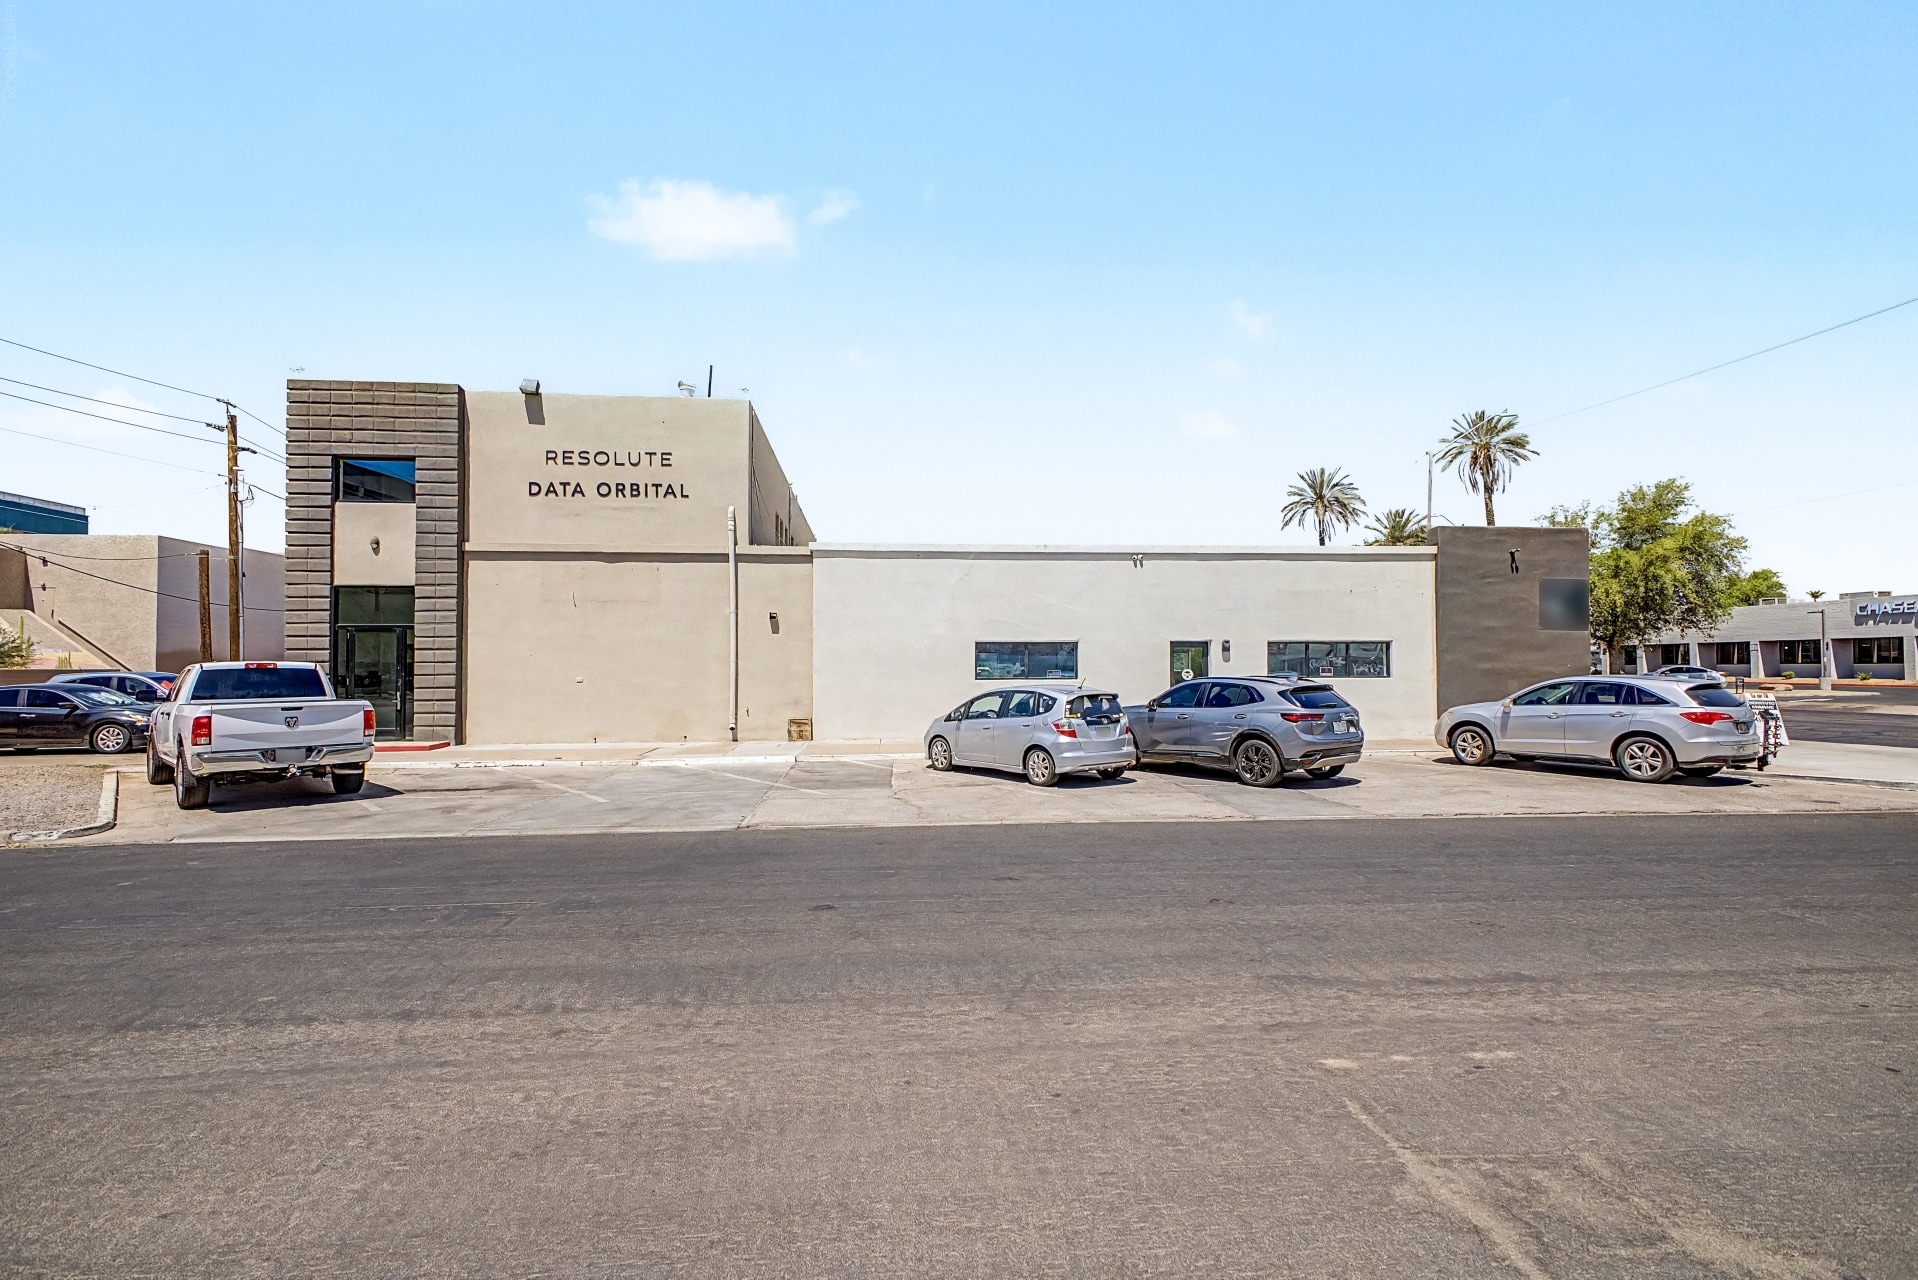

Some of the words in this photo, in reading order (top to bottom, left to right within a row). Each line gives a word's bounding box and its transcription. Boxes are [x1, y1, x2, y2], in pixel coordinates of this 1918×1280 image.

[545, 450, 673, 468] RESOLUTE
[528, 481, 586, 498] DATA
[596, 482, 690, 499] ORBITAL
[1856, 601, 1917, 615] CHASE
